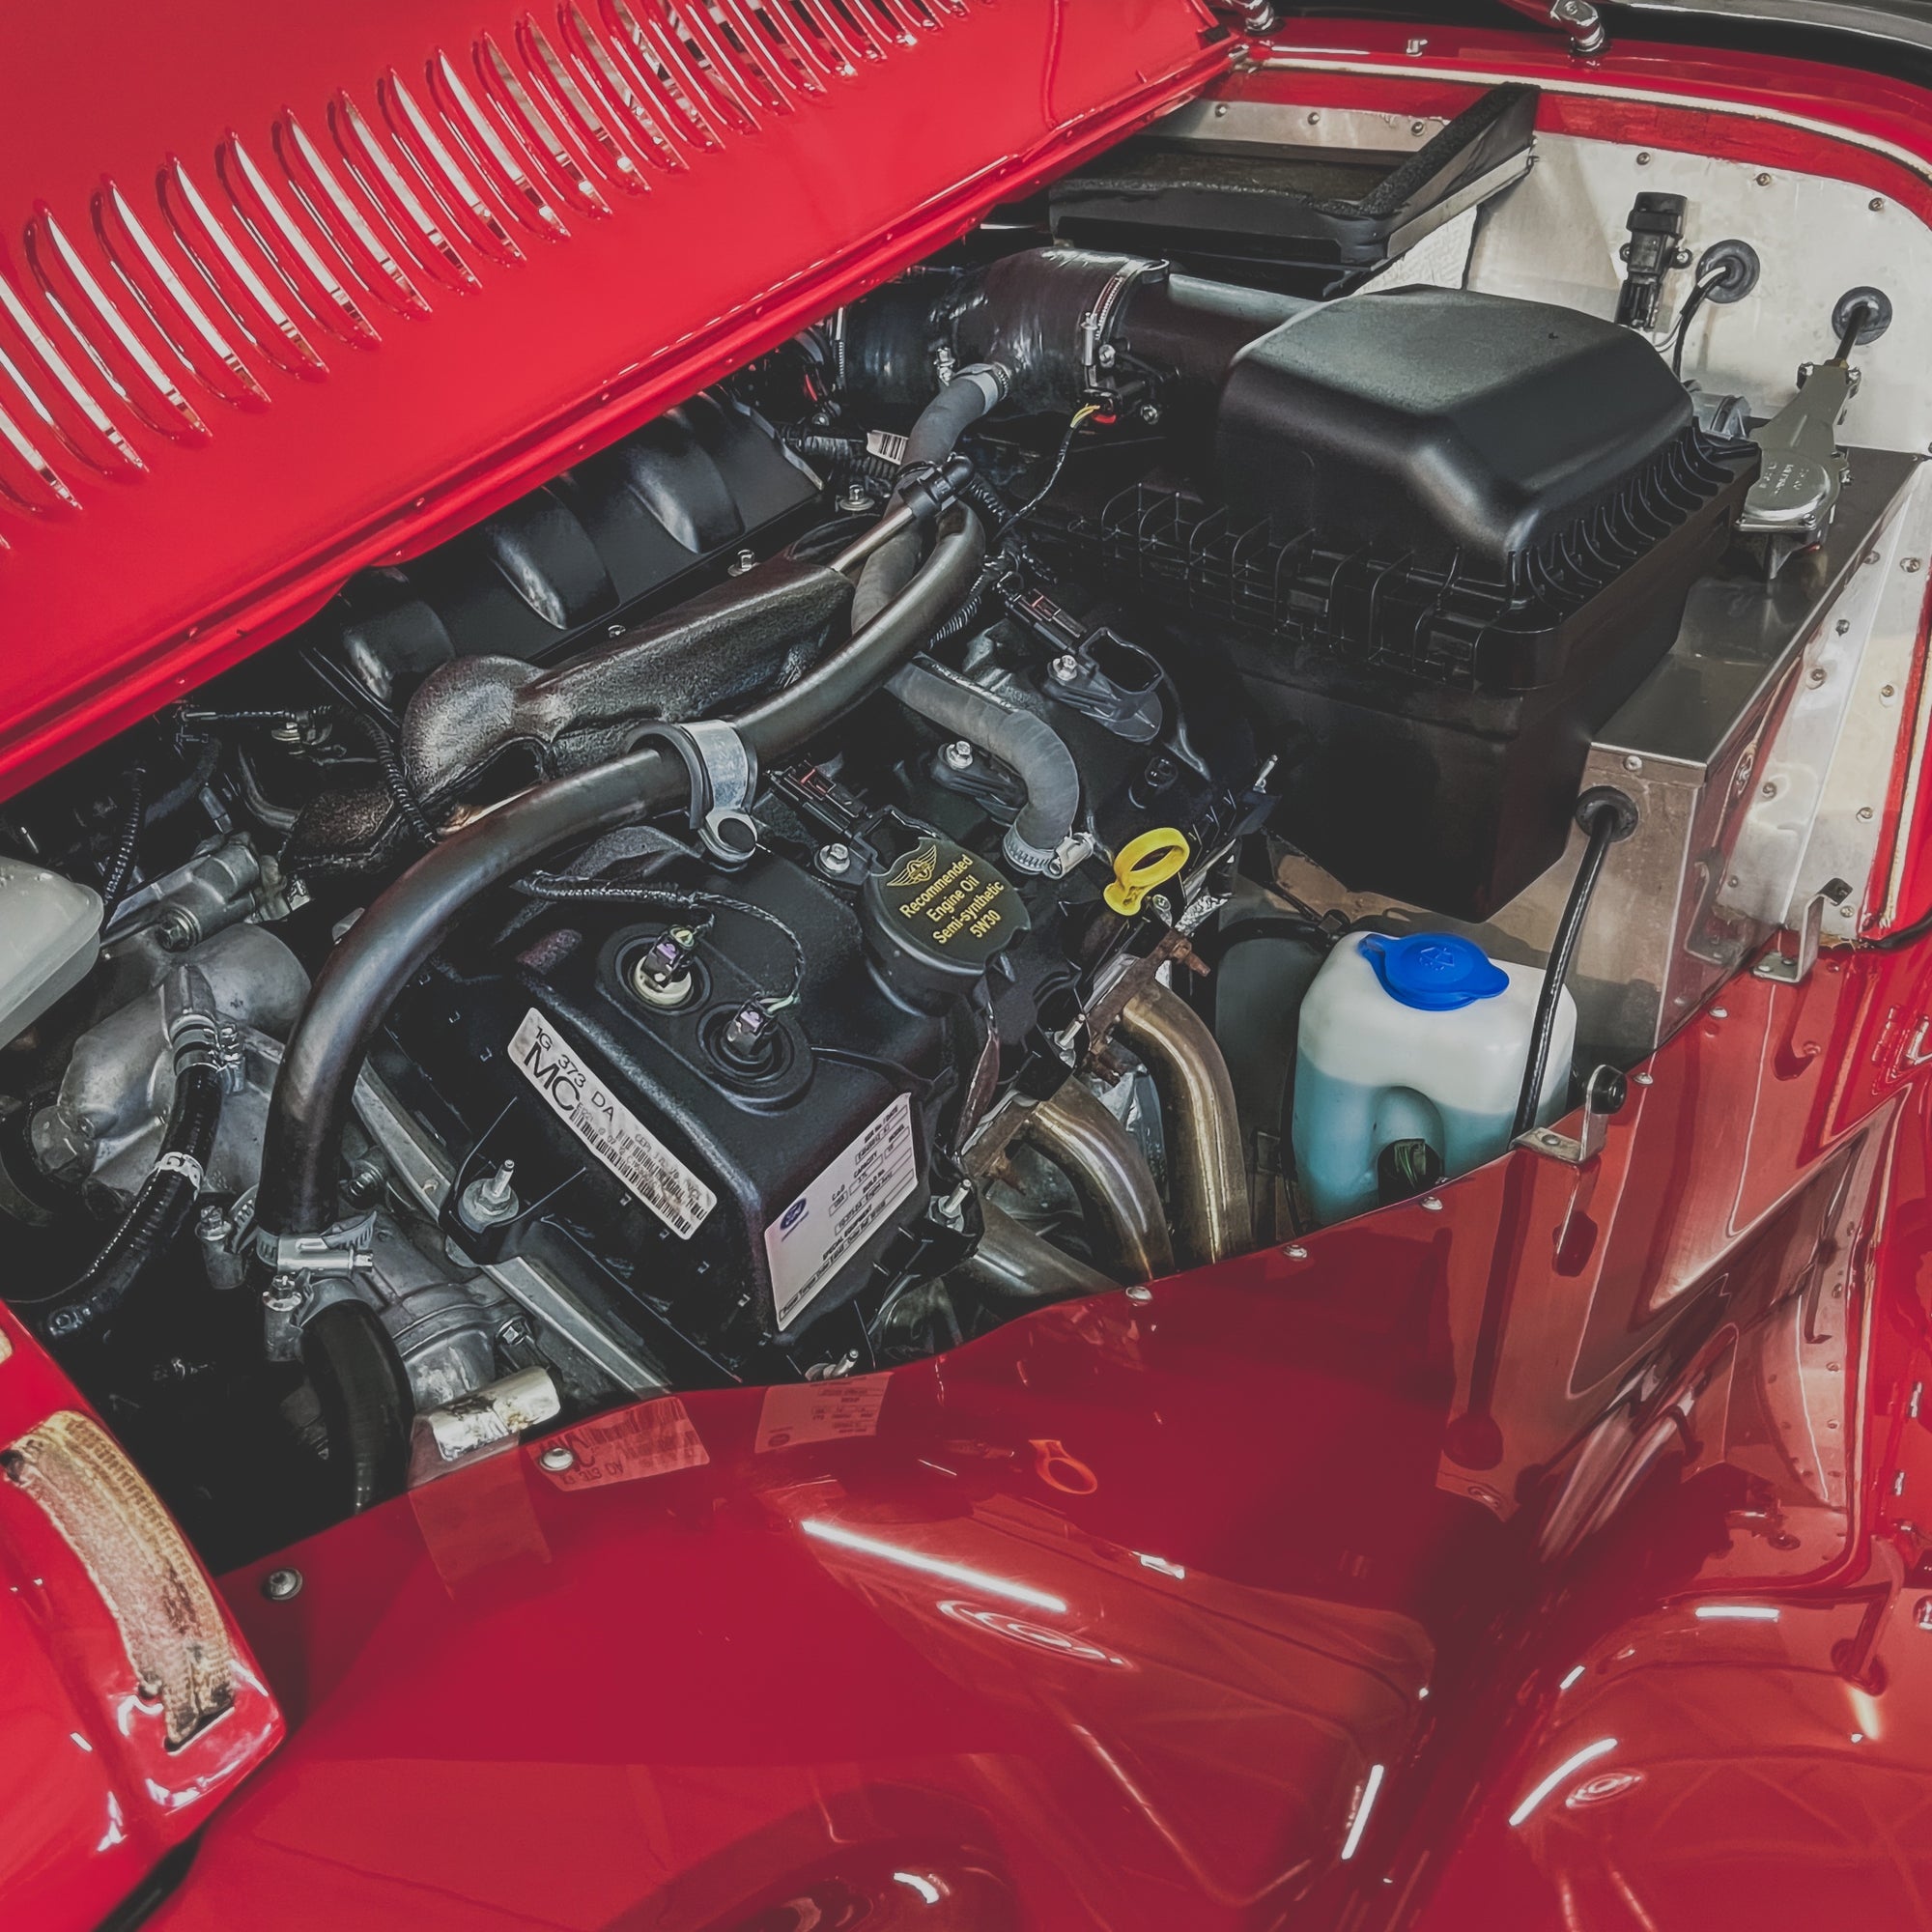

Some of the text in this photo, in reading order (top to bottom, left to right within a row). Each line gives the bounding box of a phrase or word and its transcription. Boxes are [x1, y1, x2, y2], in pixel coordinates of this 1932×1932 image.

[899, 854, 973, 918] Recommended
[925, 873, 980, 922] Engine Oil
[932, 880, 1005, 945] Semi-synthetic
[970, 909, 1002, 939] 5W30
[524, 1041, 581, 1111] MC
[535, 1027, 553, 1051] 1G
[558, 1055, 586, 1088] 373
[591, 1091, 614, 1122] DA
[853, 1150, 877, 1179] CAPACITY
[822, 1203, 871, 1261] SPECIAL EQUIPMENT
